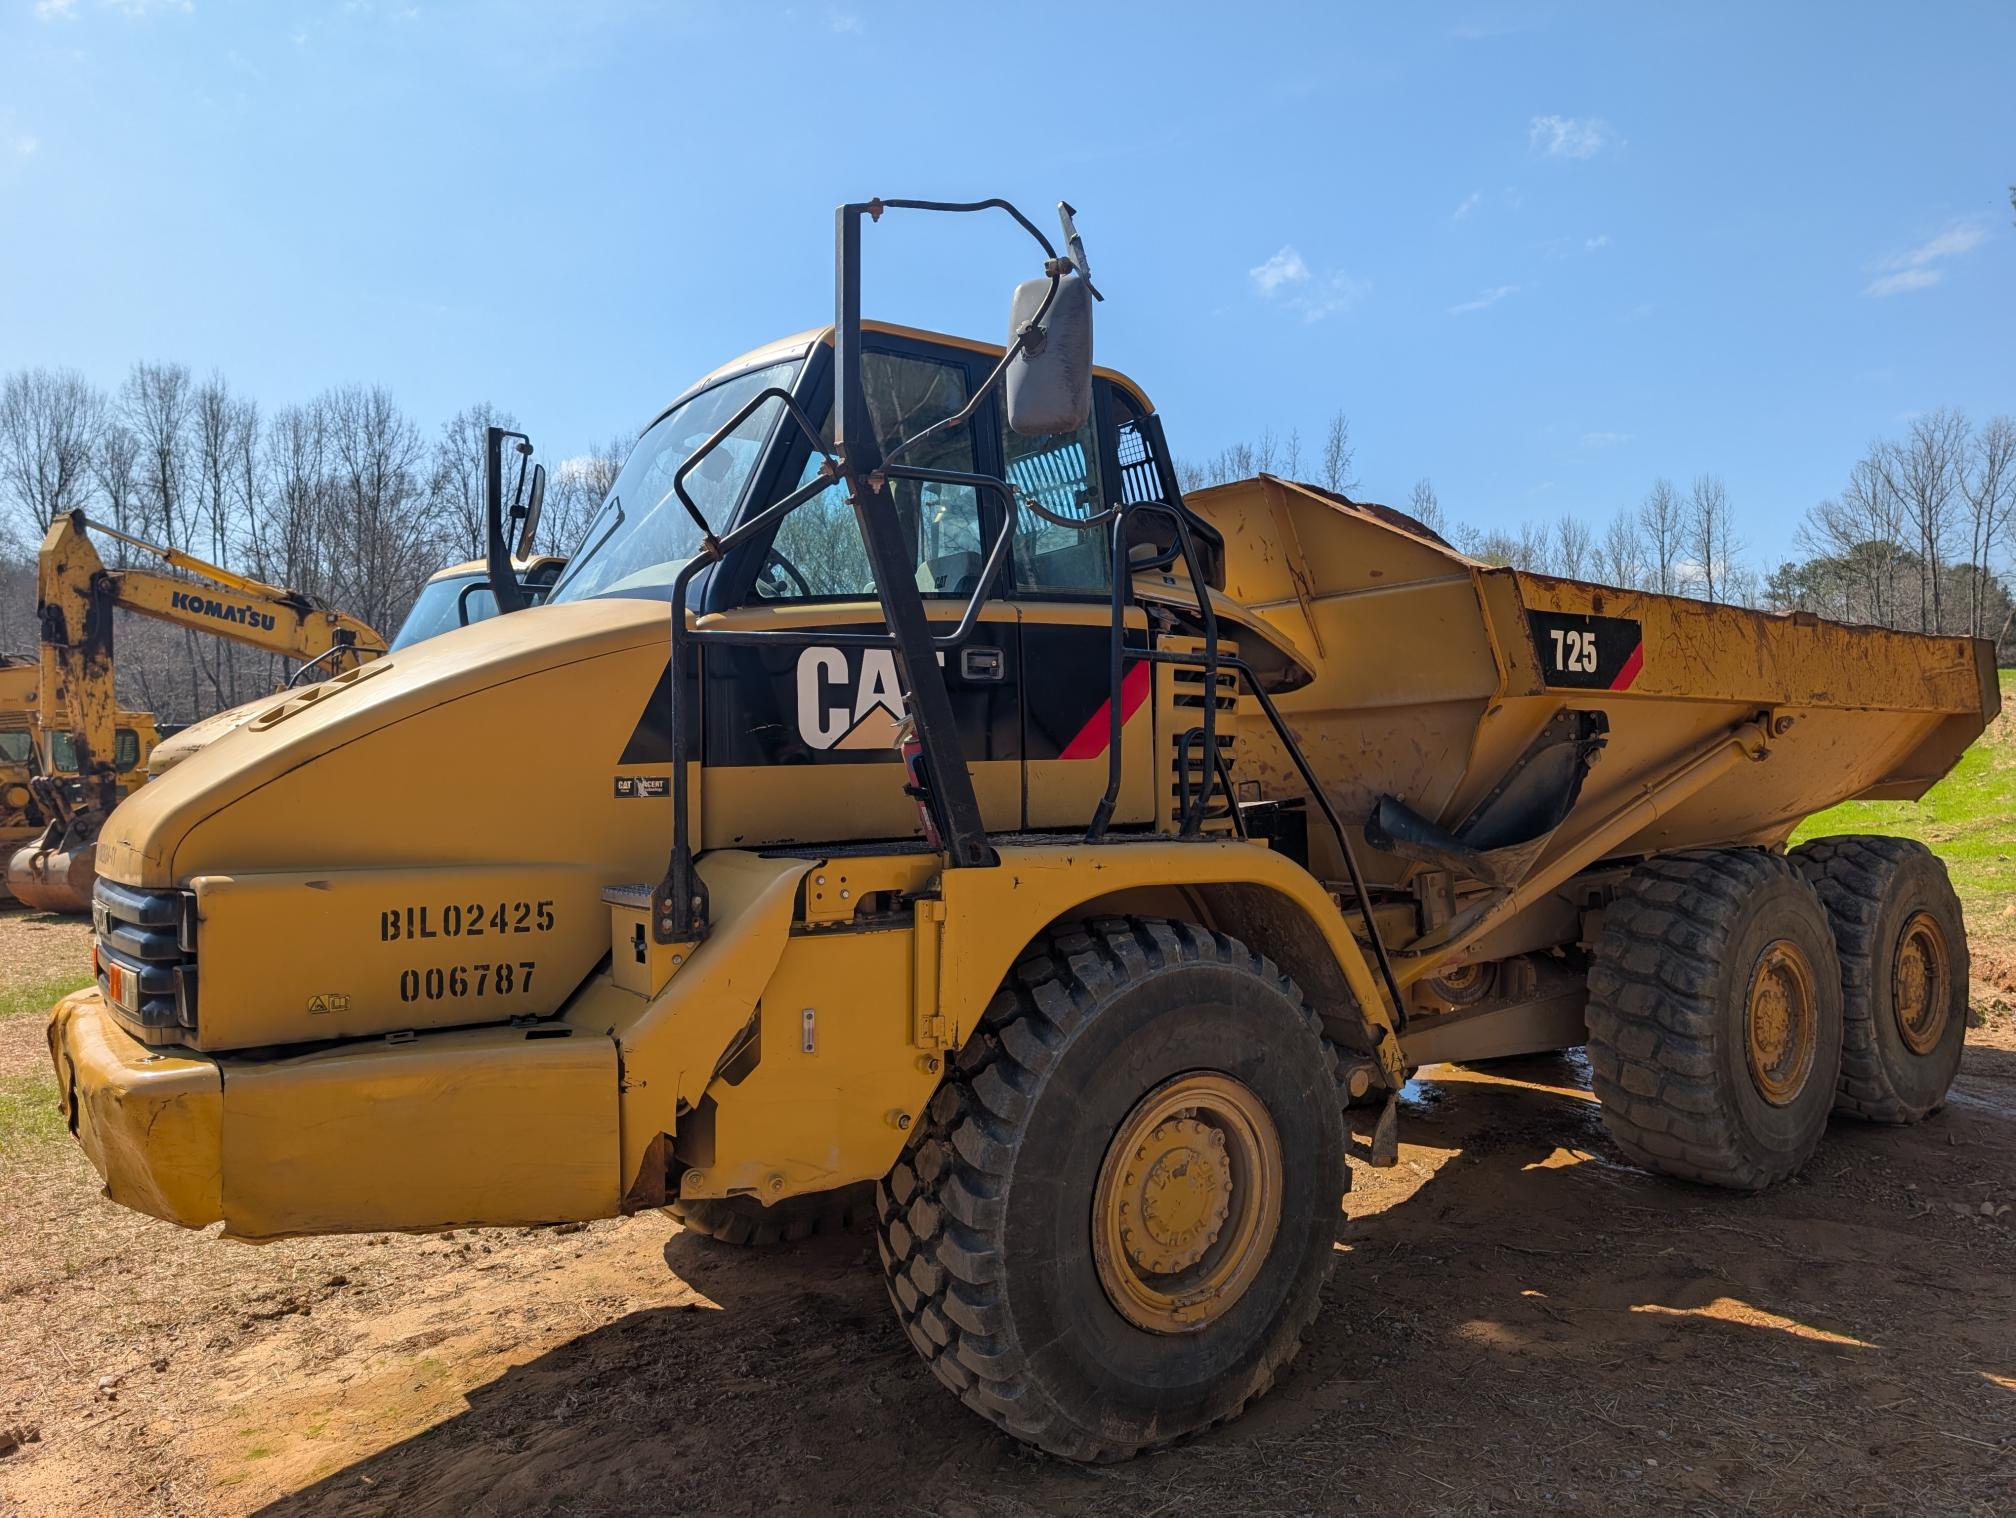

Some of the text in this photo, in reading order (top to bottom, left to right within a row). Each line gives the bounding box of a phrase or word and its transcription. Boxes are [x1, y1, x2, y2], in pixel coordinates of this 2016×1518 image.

[171, 591, 275, 631] KOMATSU
[1550, 629, 1598, 673] 725
[796, 646, 945, 750] CA
[618, 780, 632, 790] CAT
[400, 961, 536, 1003] 006787
